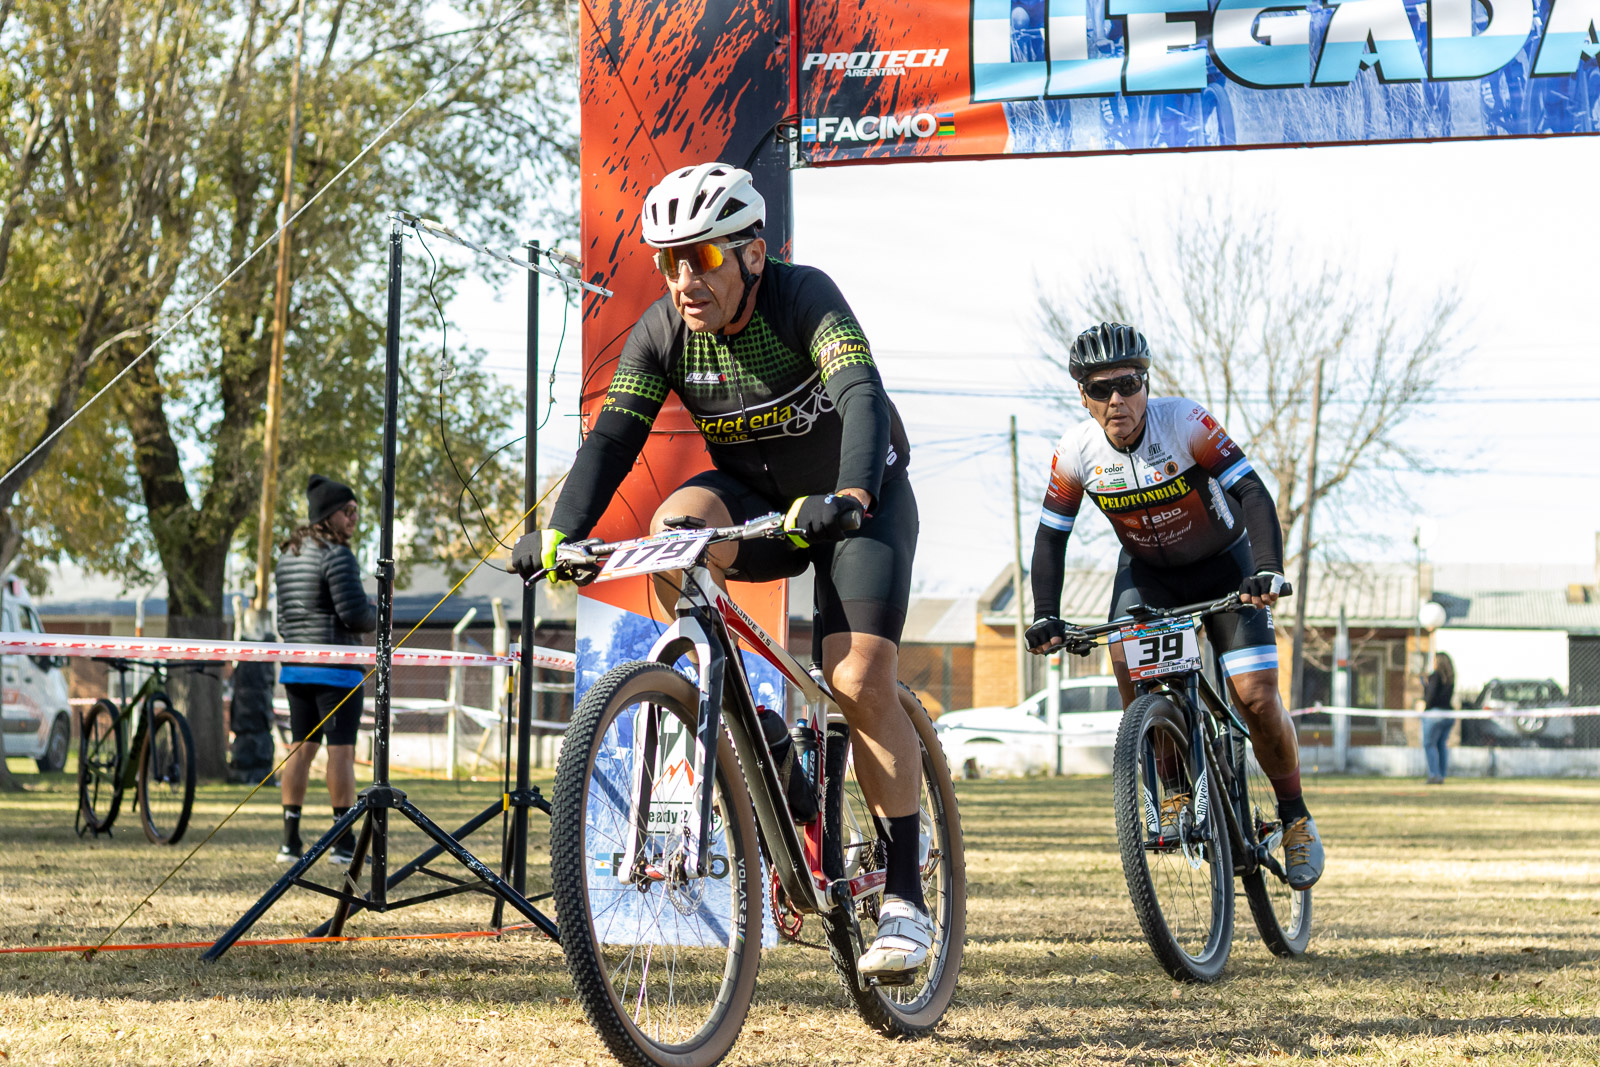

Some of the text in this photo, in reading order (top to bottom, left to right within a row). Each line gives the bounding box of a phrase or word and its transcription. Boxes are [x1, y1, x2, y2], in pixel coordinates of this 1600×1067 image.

[802, 48, 949, 71] PROTECH
[843, 67, 906, 77] ARGENTINA
[818, 113, 937, 142] FACIMO
[1104, 464, 1124, 474] color
[1098, 476, 1191, 510] PELOTONBIKE
[613, 539, 698, 569] 179
[758, 631, 772, 647] 9.5
[1139, 632, 1184, 667] 39
[648, 810, 678, 825] eady
[737, 857, 747, 911] VOLAR
